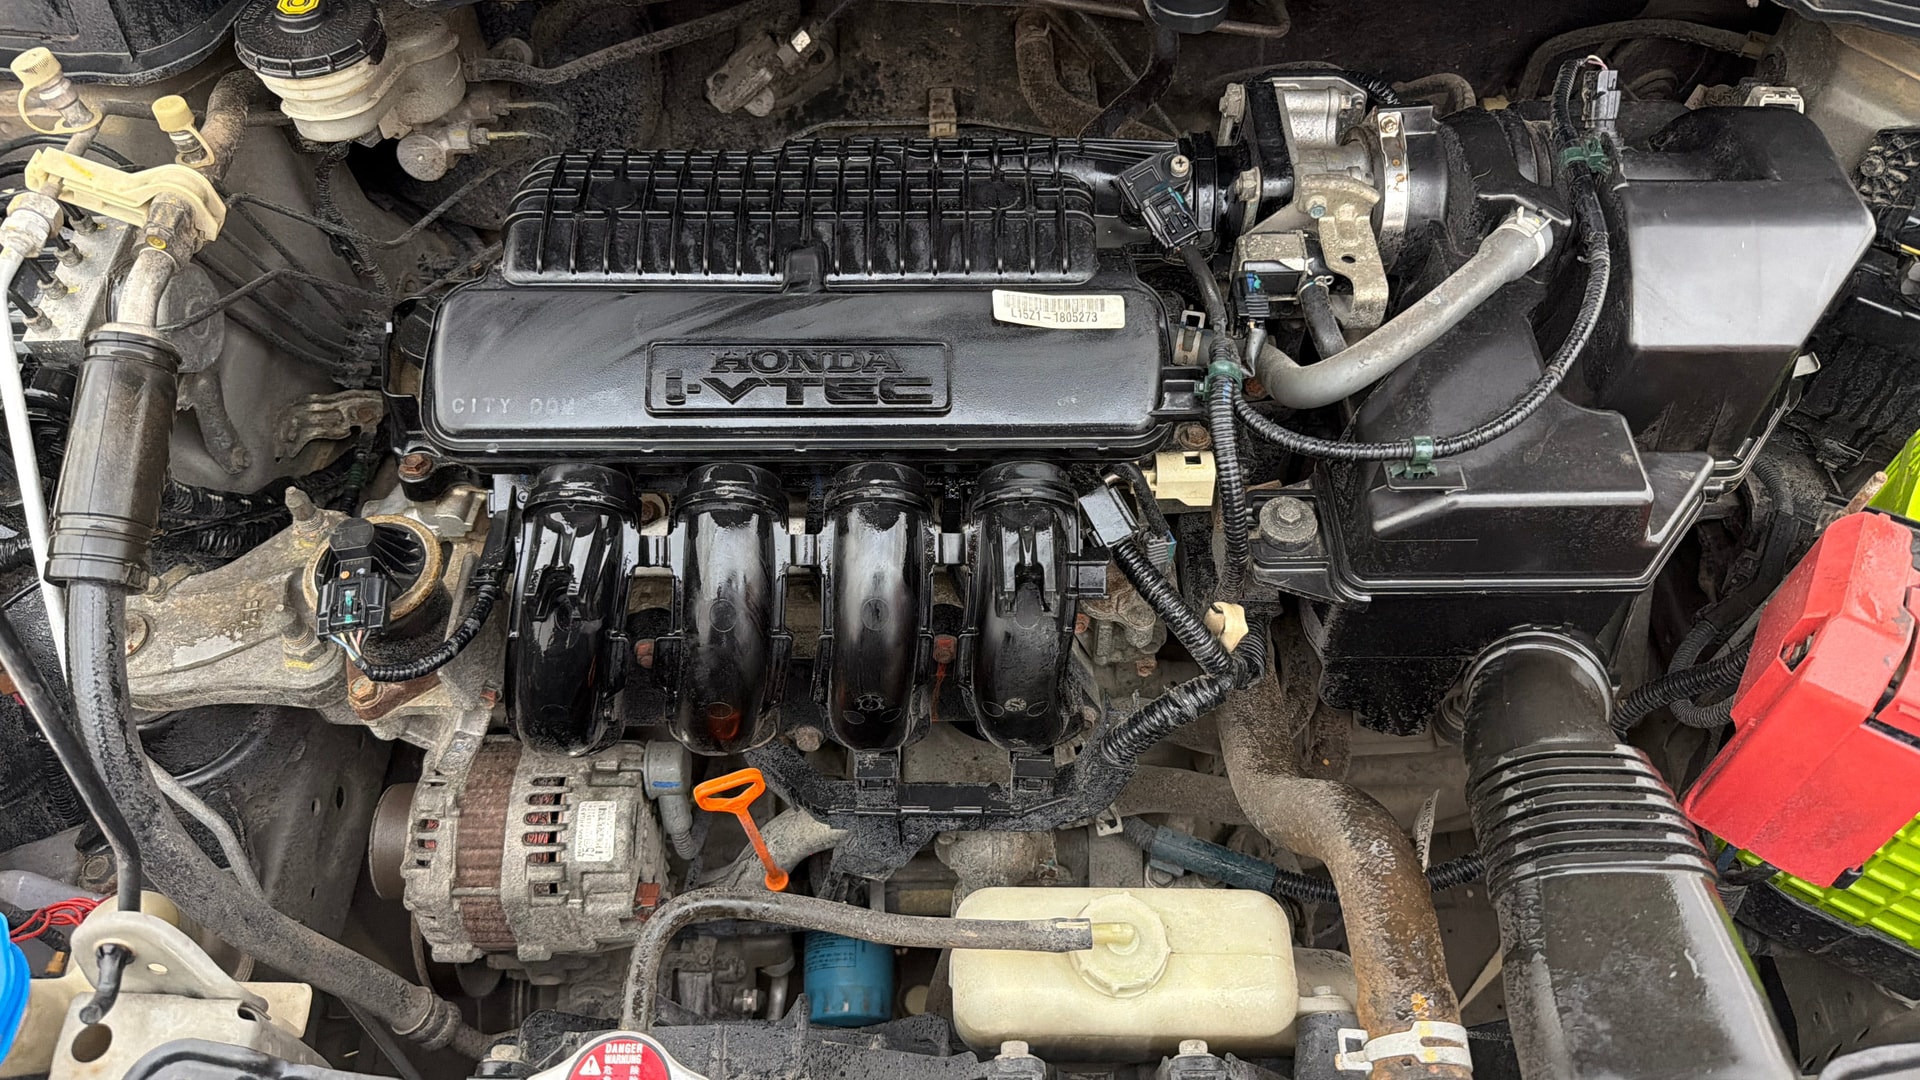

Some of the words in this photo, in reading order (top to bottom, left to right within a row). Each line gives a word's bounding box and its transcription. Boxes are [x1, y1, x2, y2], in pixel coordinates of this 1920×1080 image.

[710, 349, 904, 374] HONDA
[665, 368, 933, 405] i-VTEC
[452, 398, 510, 414] CITY
[605, 1043, 643, 1054] DANGER
